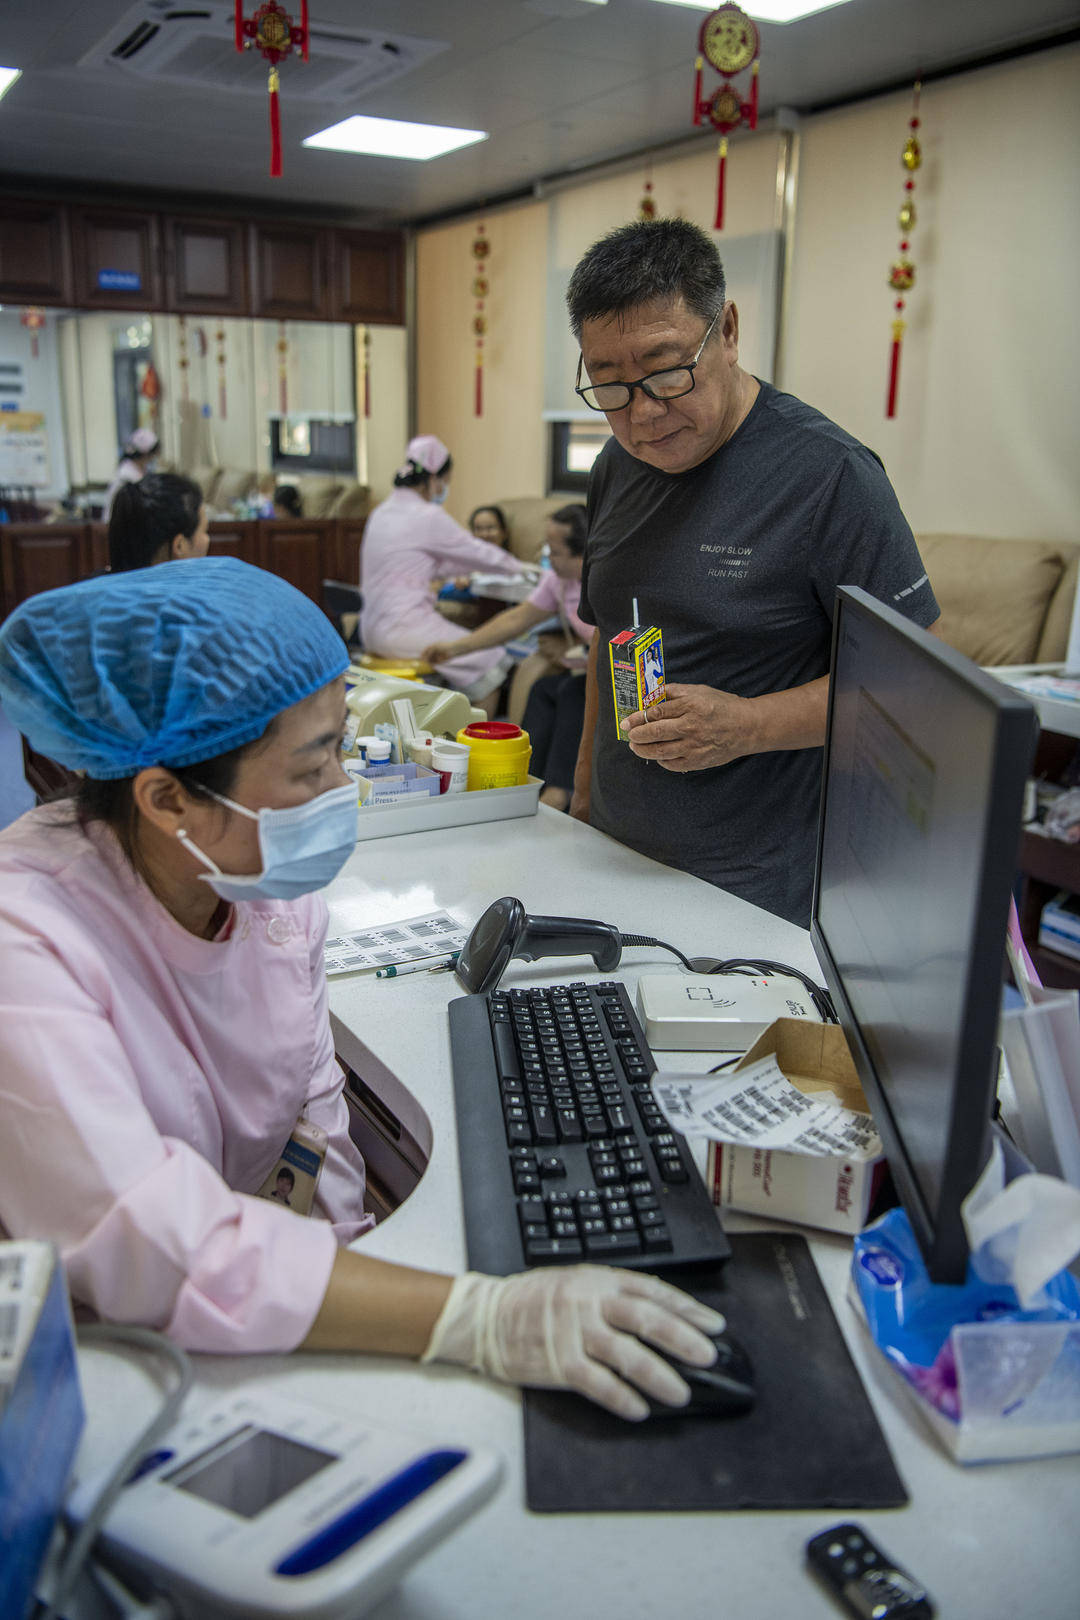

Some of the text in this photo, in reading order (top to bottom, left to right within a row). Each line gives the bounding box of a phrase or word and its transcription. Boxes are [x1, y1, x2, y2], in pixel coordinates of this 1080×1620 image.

[700, 544, 752, 555] ENJOY SLOW
[708, 568, 748, 579] RUN FAST
